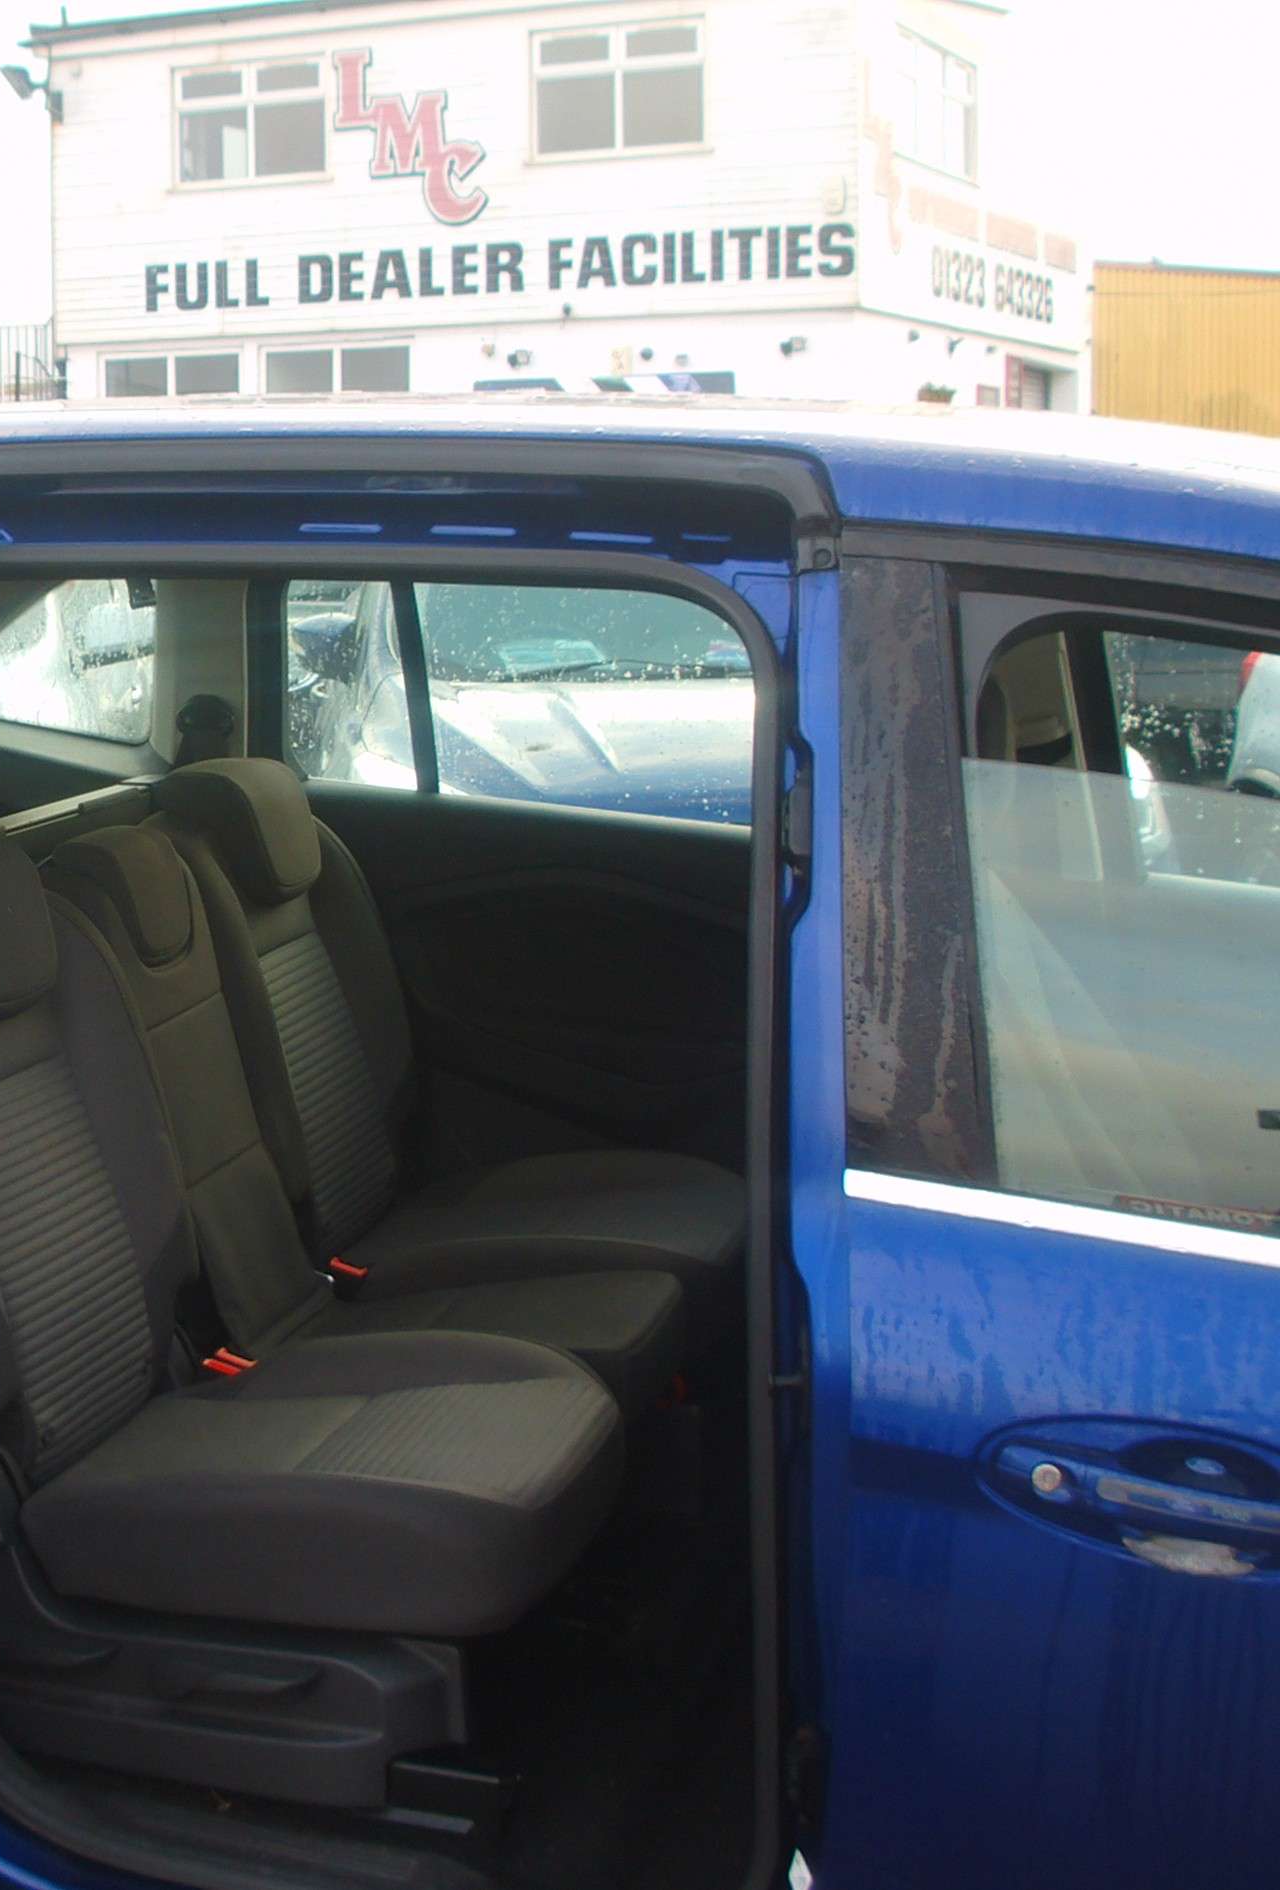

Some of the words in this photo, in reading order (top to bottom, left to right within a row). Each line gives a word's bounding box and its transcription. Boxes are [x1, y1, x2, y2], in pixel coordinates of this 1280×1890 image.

[333, 47, 488, 226] LMC
[145, 257, 271, 313] FULL
[299, 241, 524, 305] DEALER
[547, 222, 856, 289] FACILITIES
[932, 244, 985, 308] 01323
